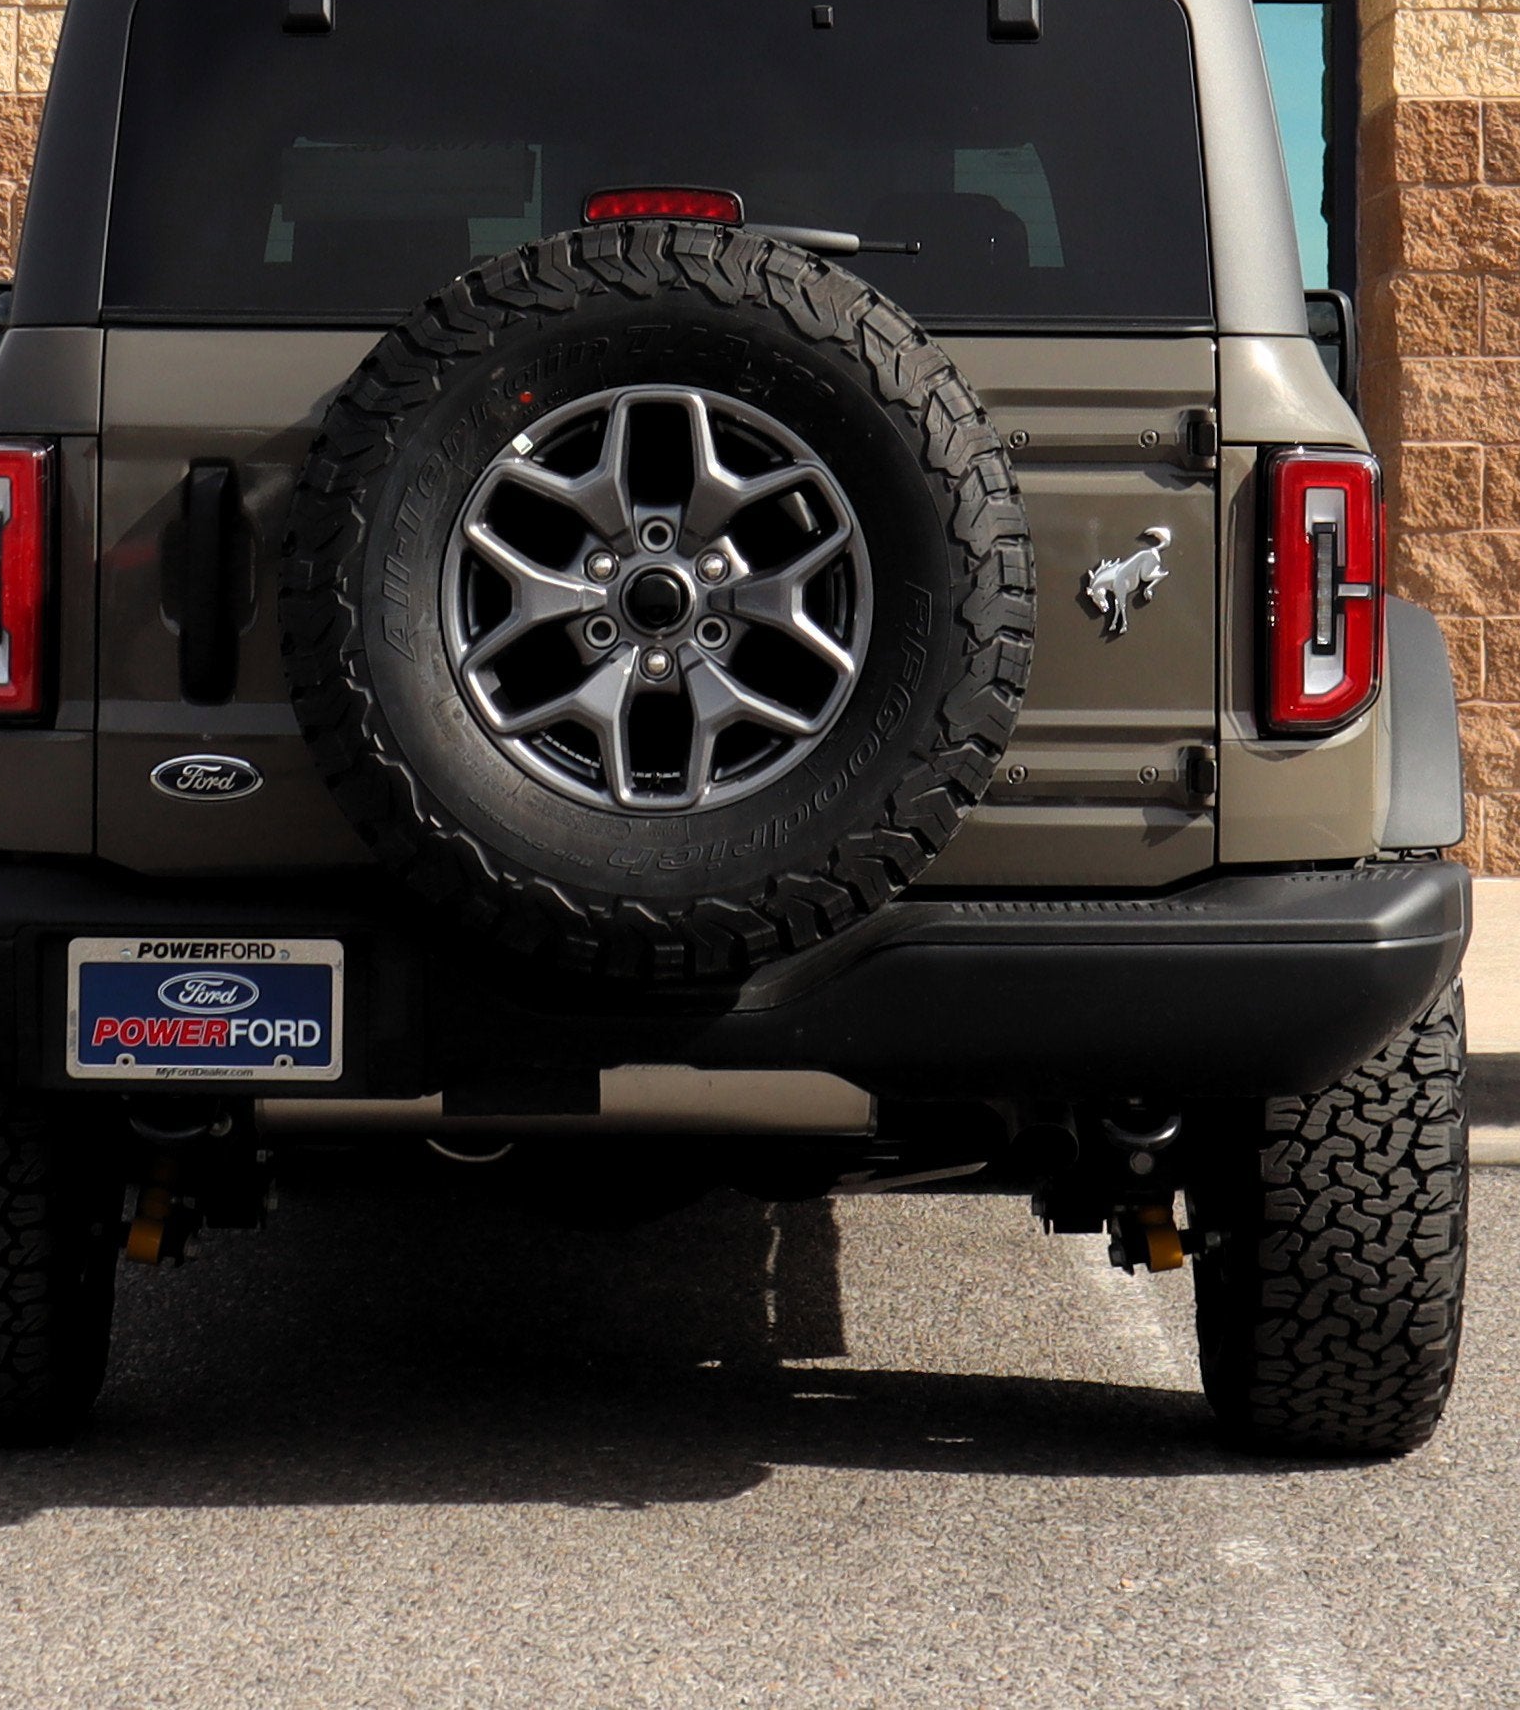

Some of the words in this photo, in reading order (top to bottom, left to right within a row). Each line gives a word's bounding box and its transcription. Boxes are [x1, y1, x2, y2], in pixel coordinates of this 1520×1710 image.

[605, 576, 937, 875] BFGoodrich
[176, 763, 236, 792] Ford
[136, 942, 276, 960] POWERFORD
[178, 979, 238, 1006] Ford
[91, 1017, 322, 1048] POWERFORD
[154, 1067, 254, 1079] MyFordDealer.com
